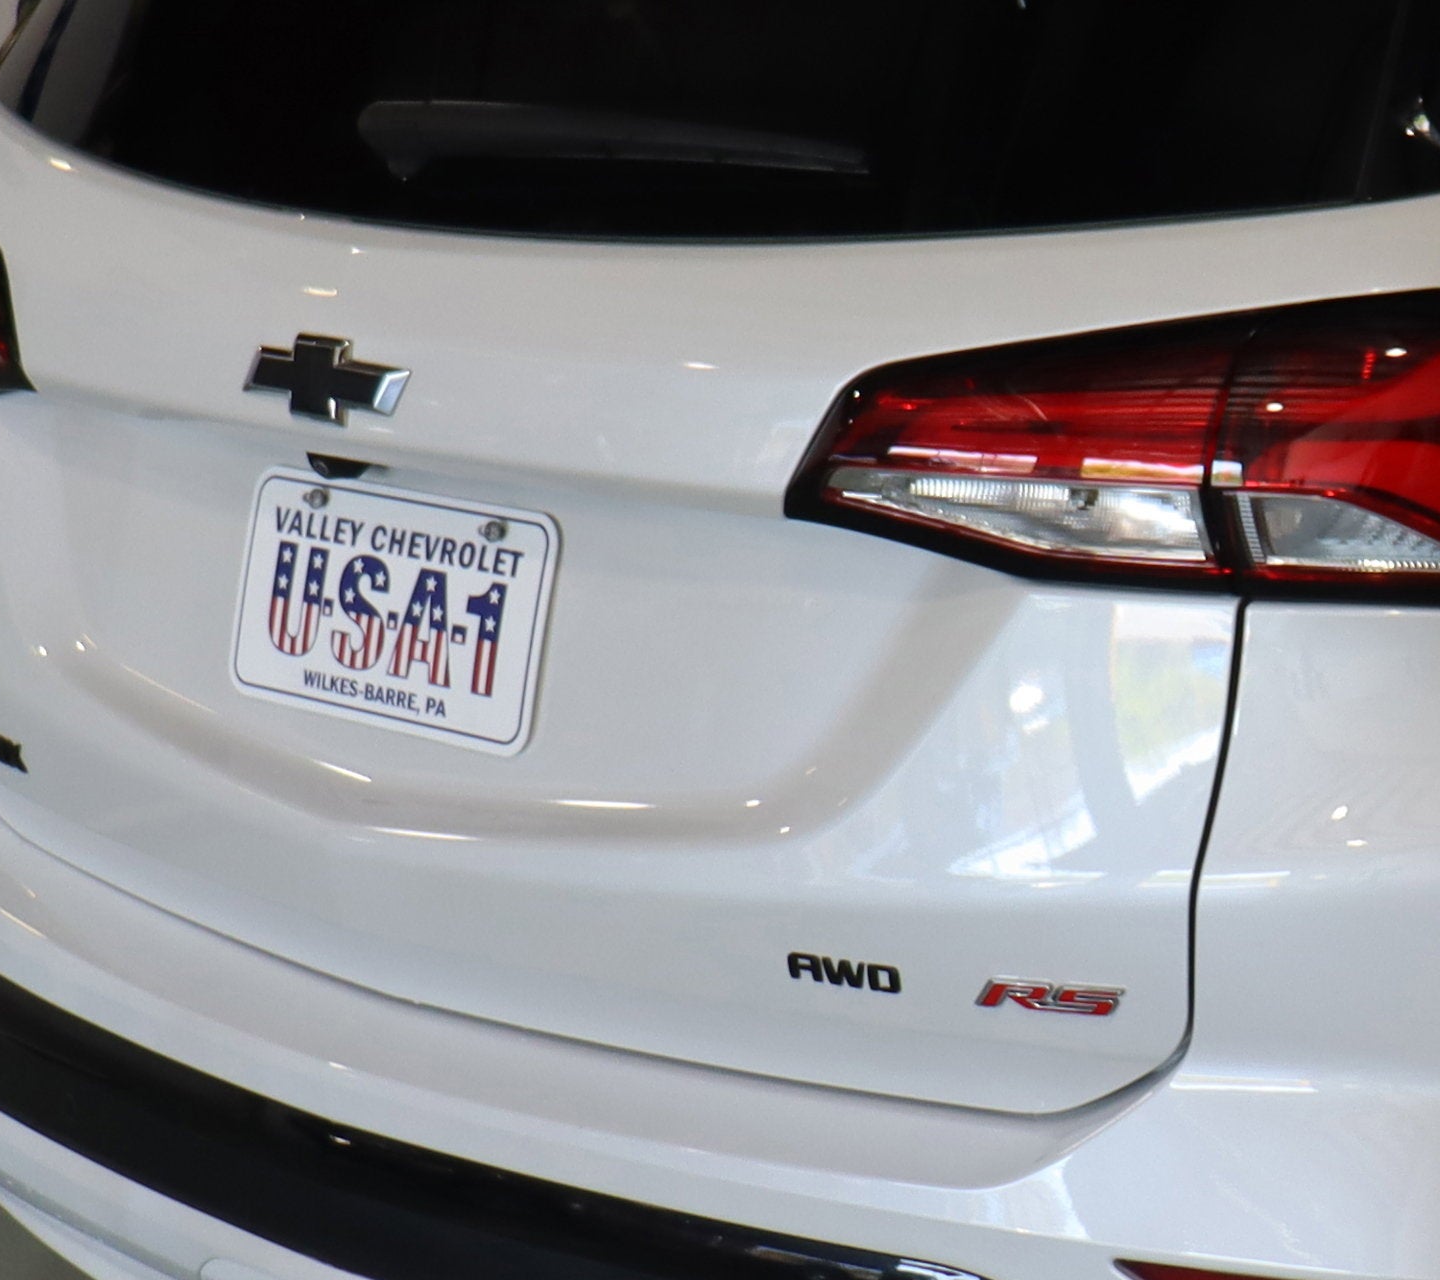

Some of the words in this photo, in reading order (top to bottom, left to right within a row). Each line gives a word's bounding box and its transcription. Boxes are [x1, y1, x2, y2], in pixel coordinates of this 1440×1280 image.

[275, 506, 366, 548] VALLEY
[370, 525, 525, 579] CHEVROLET
[303, 670, 421, 715] WILKES-BARRE,
[425, 697, 448, 719] PA
[786, 951, 902, 994] AWD
[974, 974, 1126, 1016] RS
